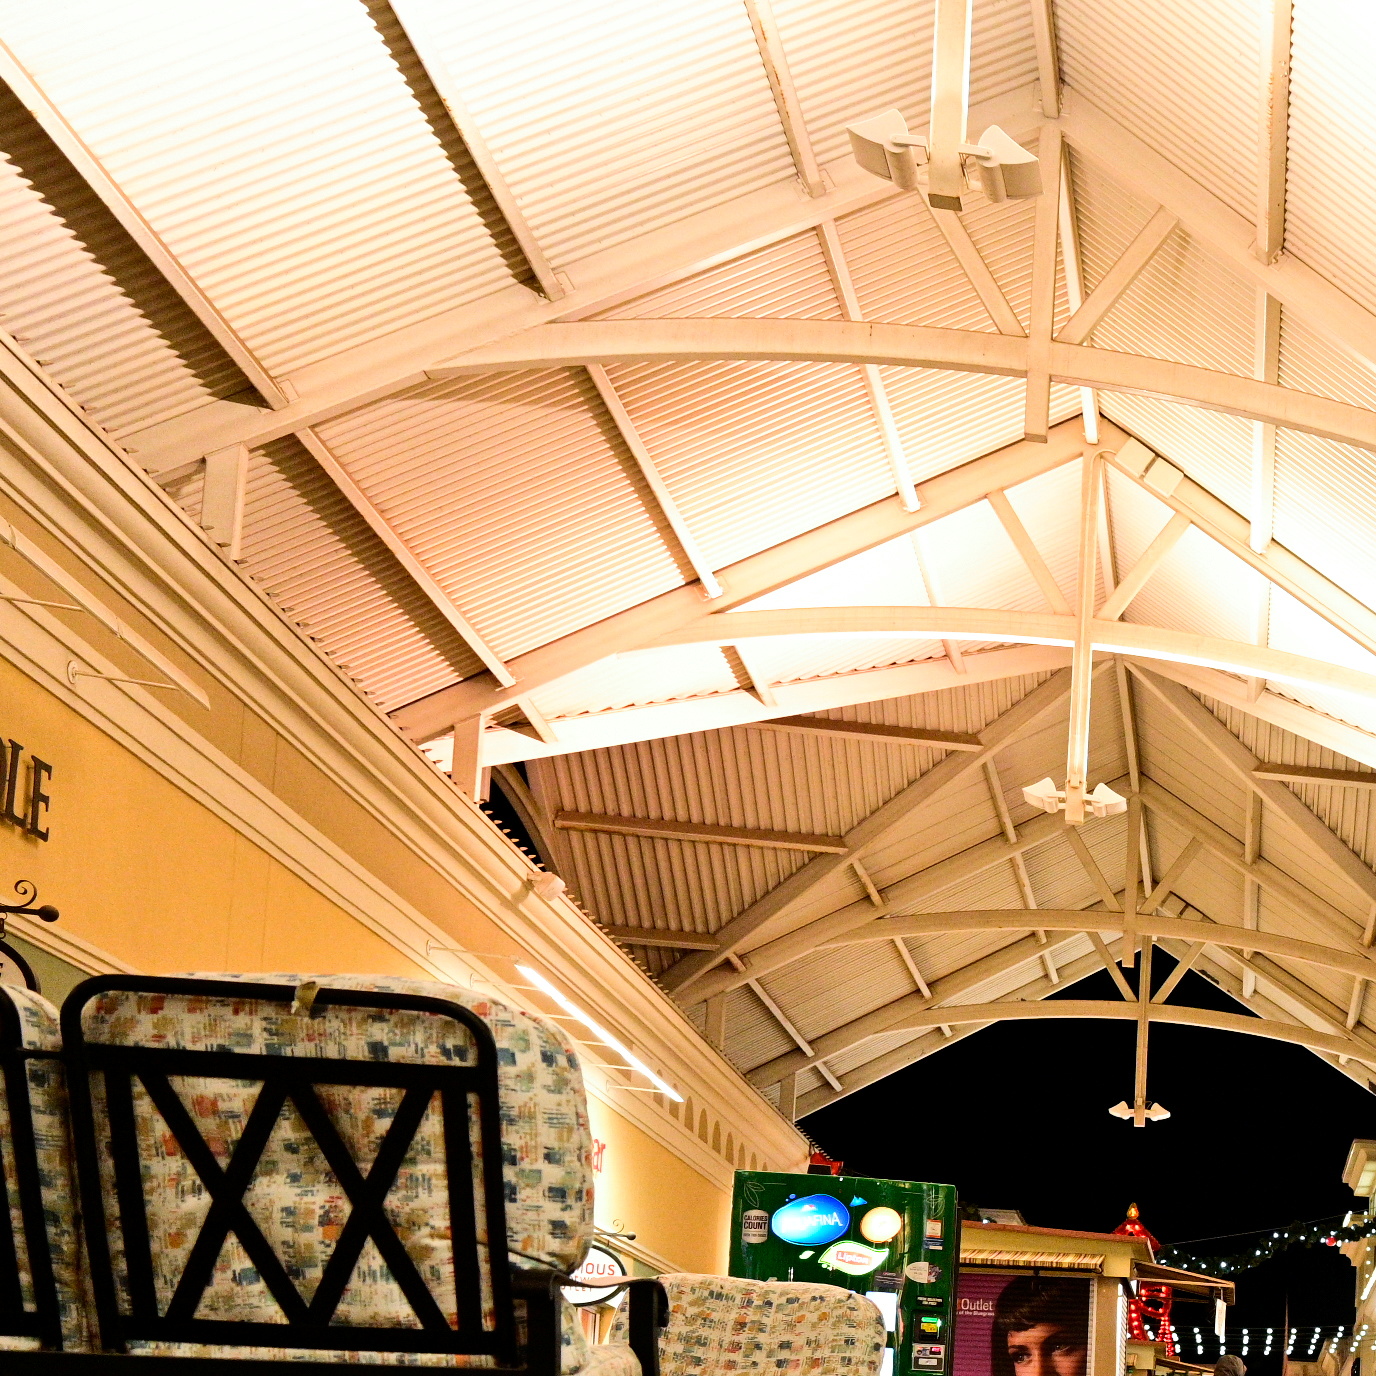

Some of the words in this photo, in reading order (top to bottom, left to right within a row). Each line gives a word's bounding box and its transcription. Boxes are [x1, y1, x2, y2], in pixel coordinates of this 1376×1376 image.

[0, 737, 53, 842] LE
[743, 1221, 768, 1231] COUNT
[837, 1251, 870, 1265] Lipton
[580, 1262, 616, 1276] OUS
[961, 1298, 993, 1310] Outlet
